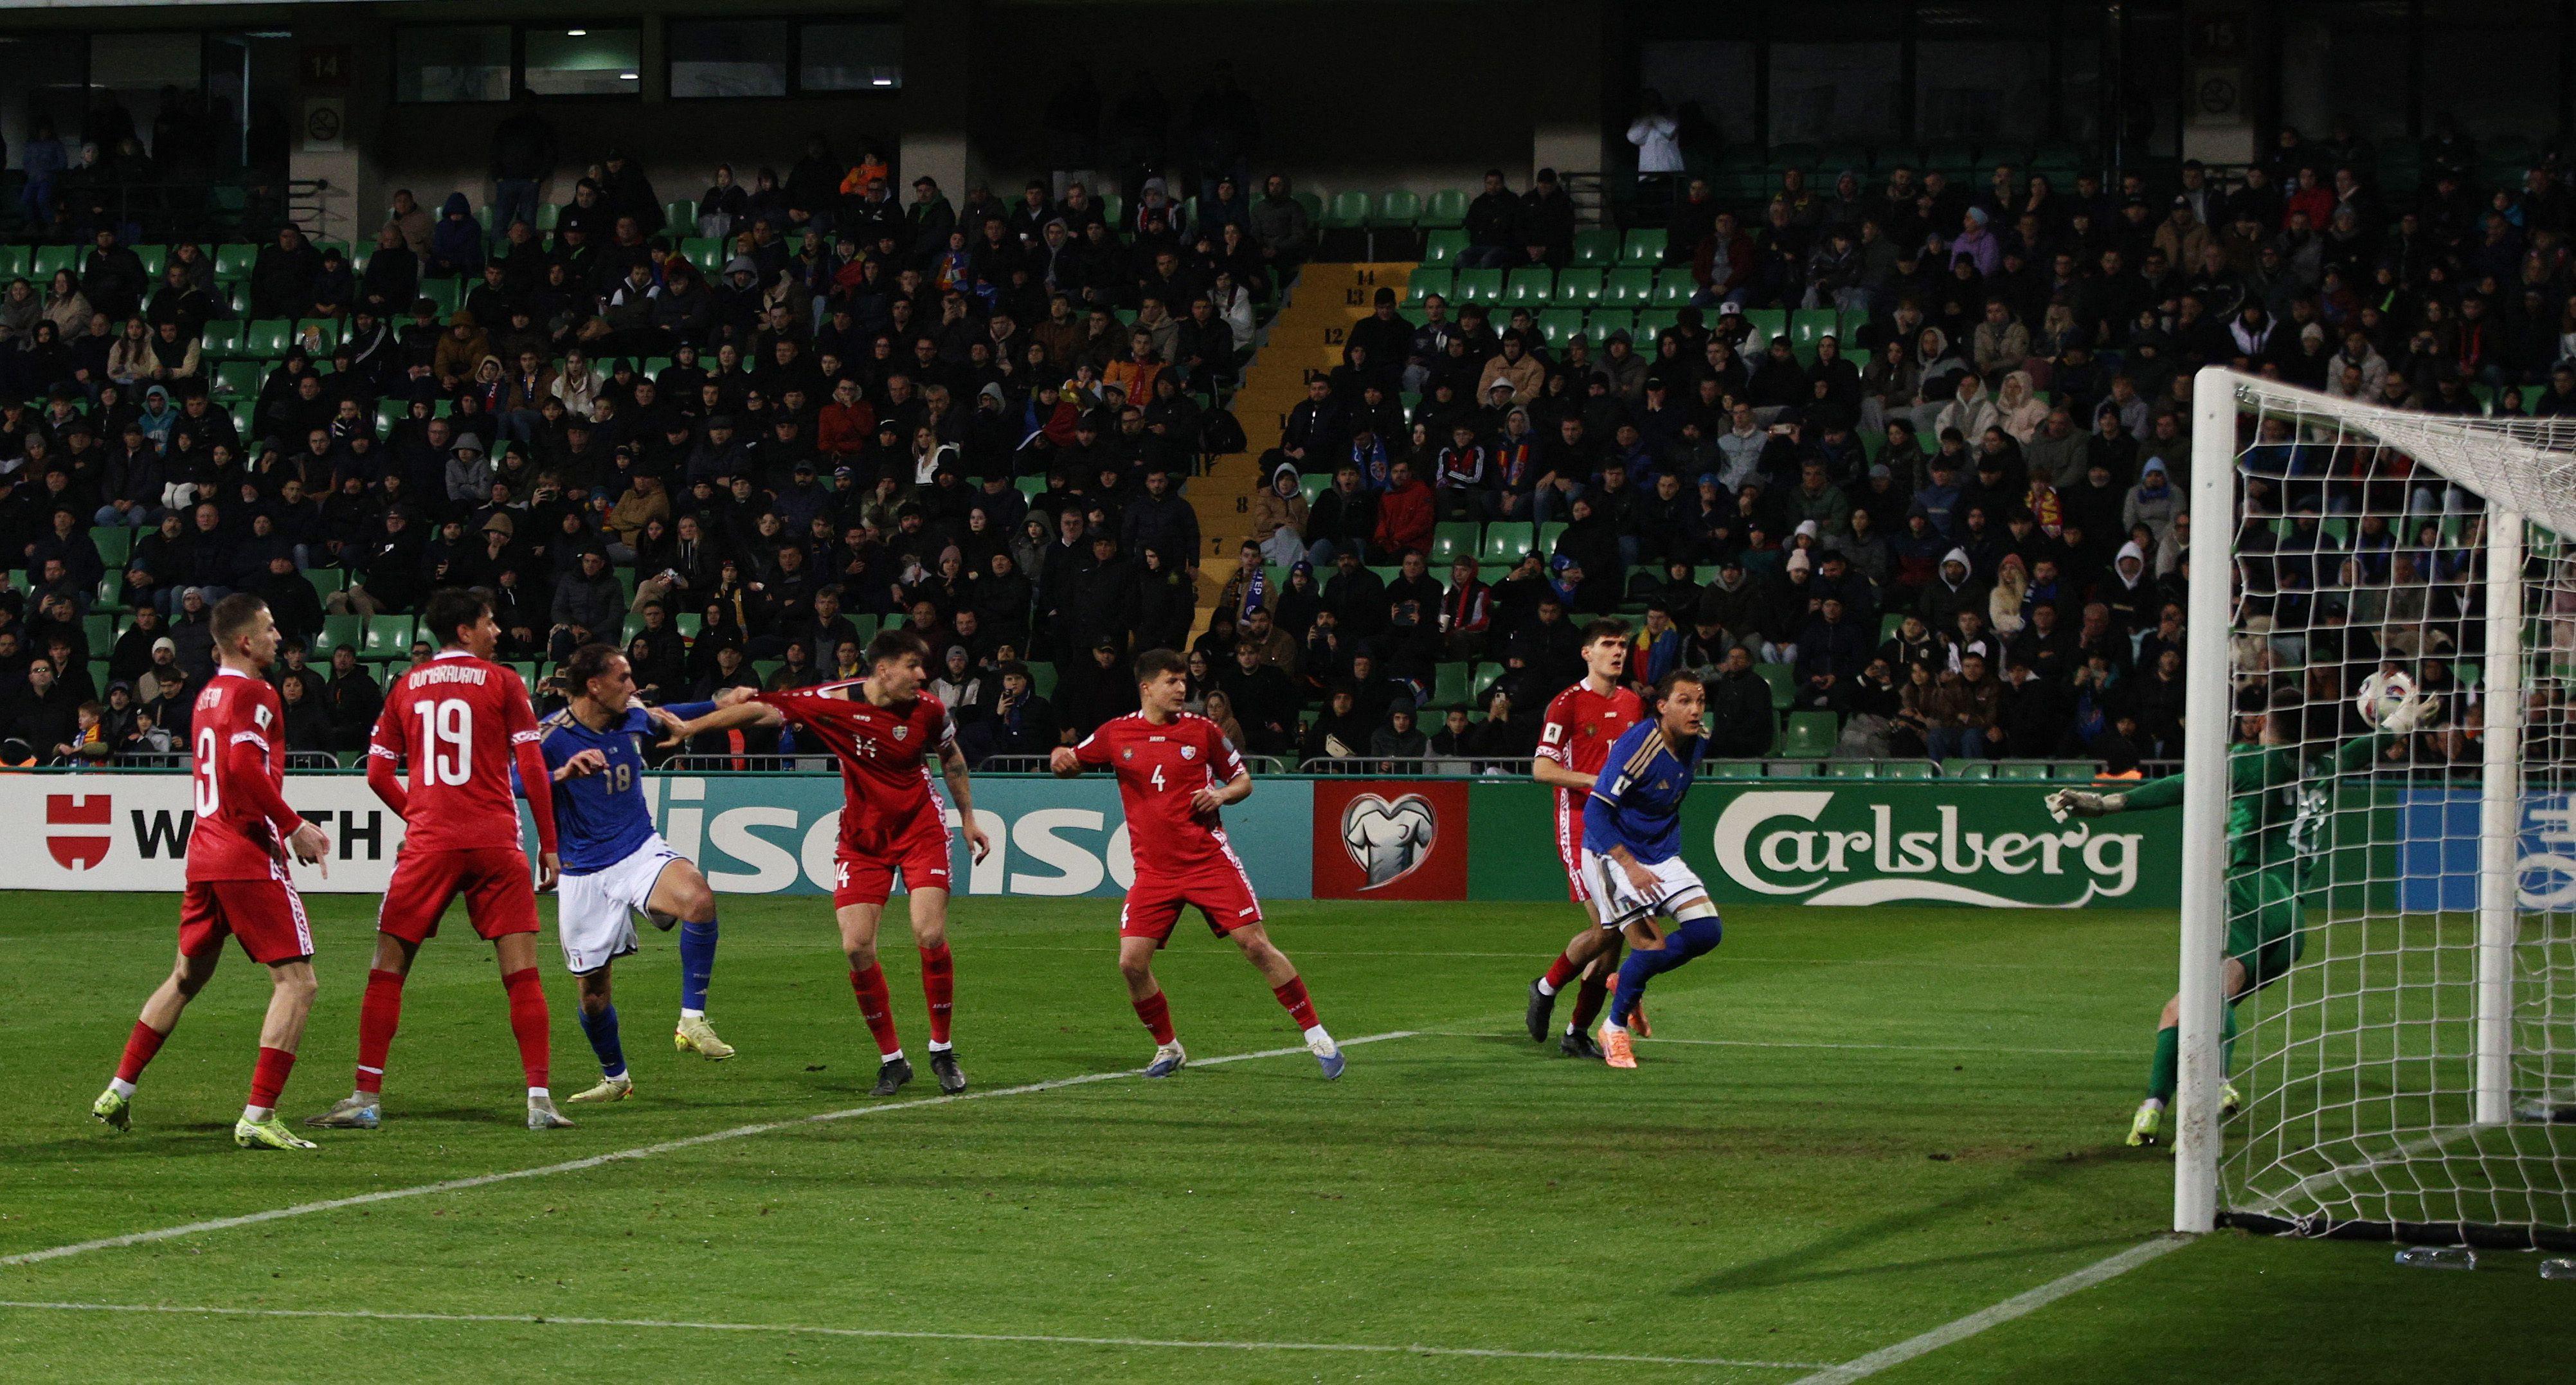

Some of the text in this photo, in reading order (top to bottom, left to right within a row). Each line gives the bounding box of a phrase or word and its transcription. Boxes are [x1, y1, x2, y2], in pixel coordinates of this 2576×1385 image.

[312, 55, 339, 78] 14
[1346, 289, 1365, 305] 13
[1324, 327, 1344, 345] 12
[1236, 496, 1248, 512] 8
[1212, 538, 1223, 555] 7
[413, 698, 473, 786] 19
[852, 734, 877, 758] 14
[195, 727, 219, 819] 3
[602, 763, 631, 795] 18
[1150, 763, 1167, 793] 4
[1713, 792, 2143, 897] Carlsberg
